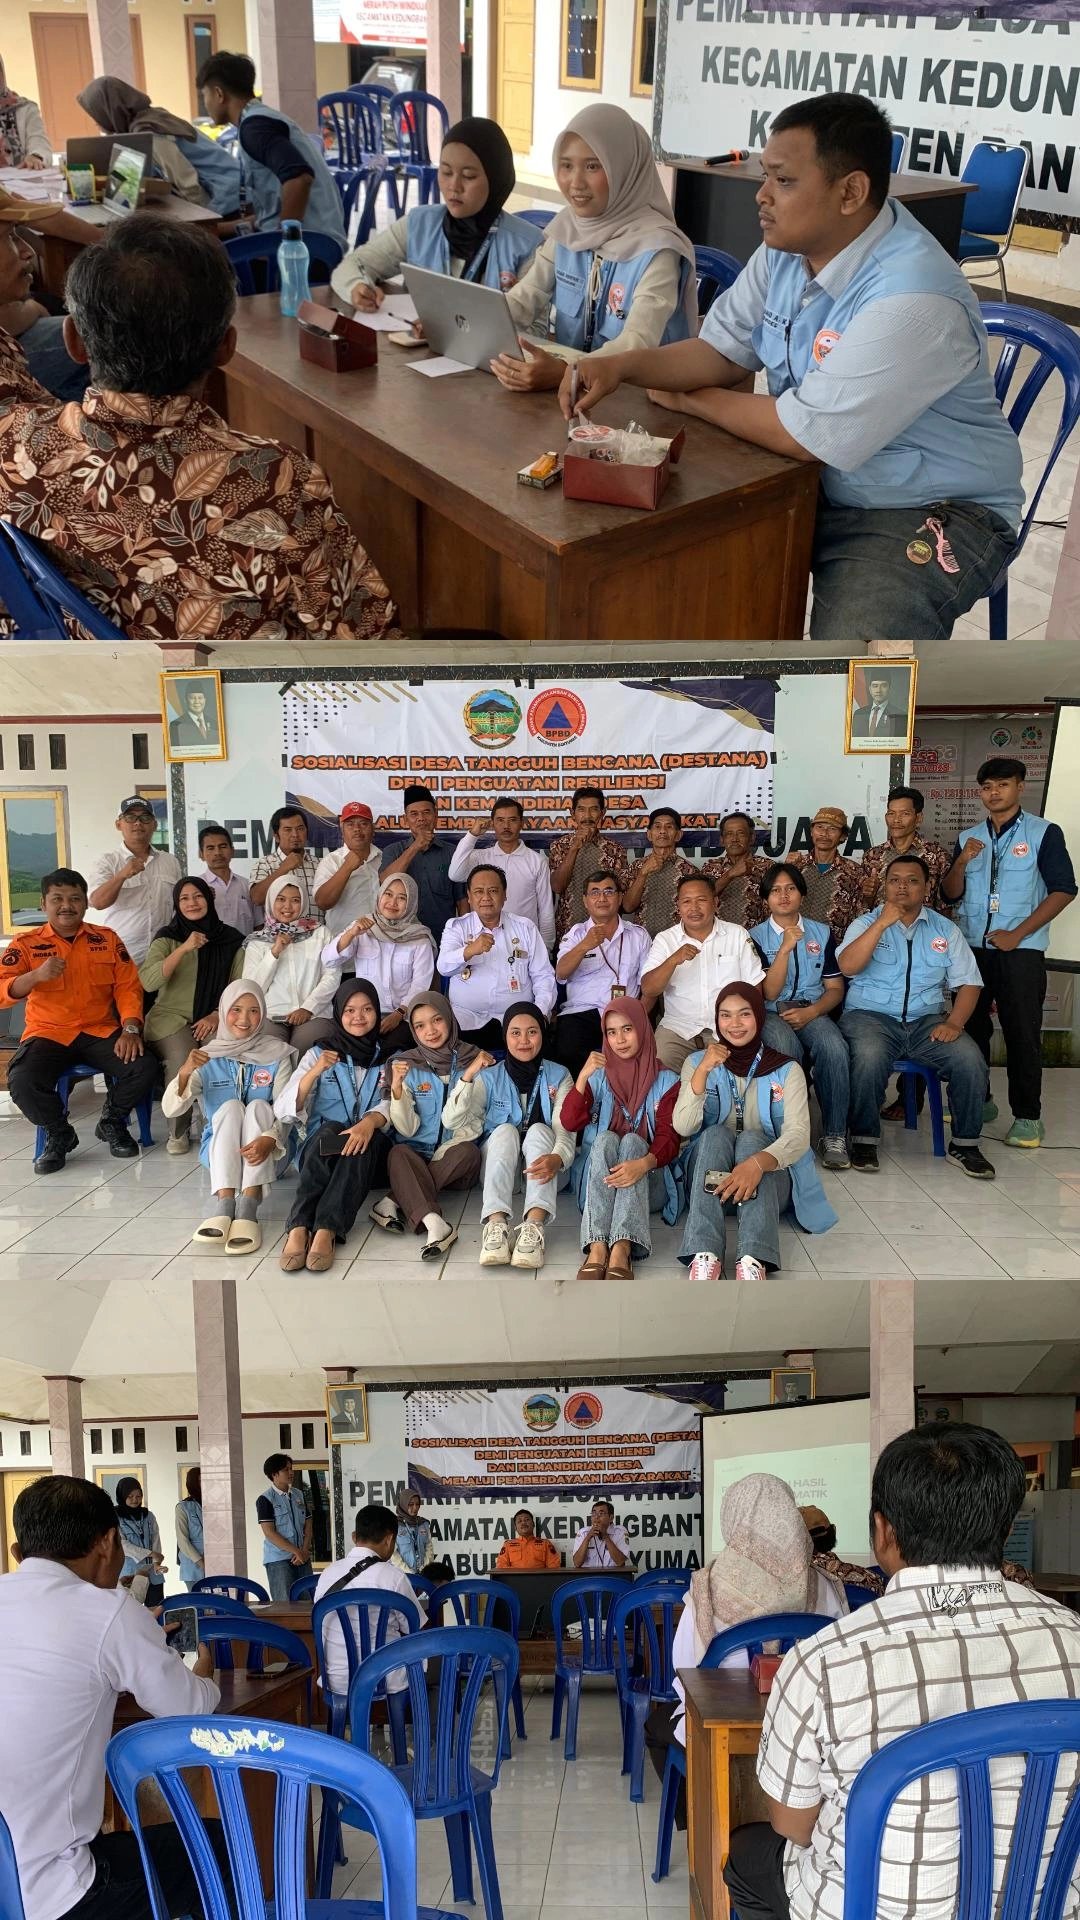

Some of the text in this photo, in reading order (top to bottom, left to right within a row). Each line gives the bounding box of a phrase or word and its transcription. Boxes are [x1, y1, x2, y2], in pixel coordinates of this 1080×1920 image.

[702, 45, 907, 99] KECAMATAN
[545, 730, 571, 738] BPBD
[292, 751, 768, 771] SOSIALISASI DESA TANGGUH BENCANA (DESTANA)
[441, 776, 559, 791] PENGUATAN
[562, 774, 666, 790] RESILIENSI
[603, 795, 648, 810] ESA
[411, 1438, 487, 1448] SOSIALISASI
[488, 1437, 523, 1447] DESA
[523, 1435, 585, 1447] TANGGUH
[587, 1434, 650, 1445] BENCANA
[475, 1446, 655, 1460] DEMI PENGUATAN RESILIENSI
[487, 1460, 643, 1472] DAN KEMANDIRIAN DESA
[441, 1471, 691, 1486] MELALUI PEMBERDAYAAN MASYARAKAT
[793, 1478, 828, 1488] HASIL
